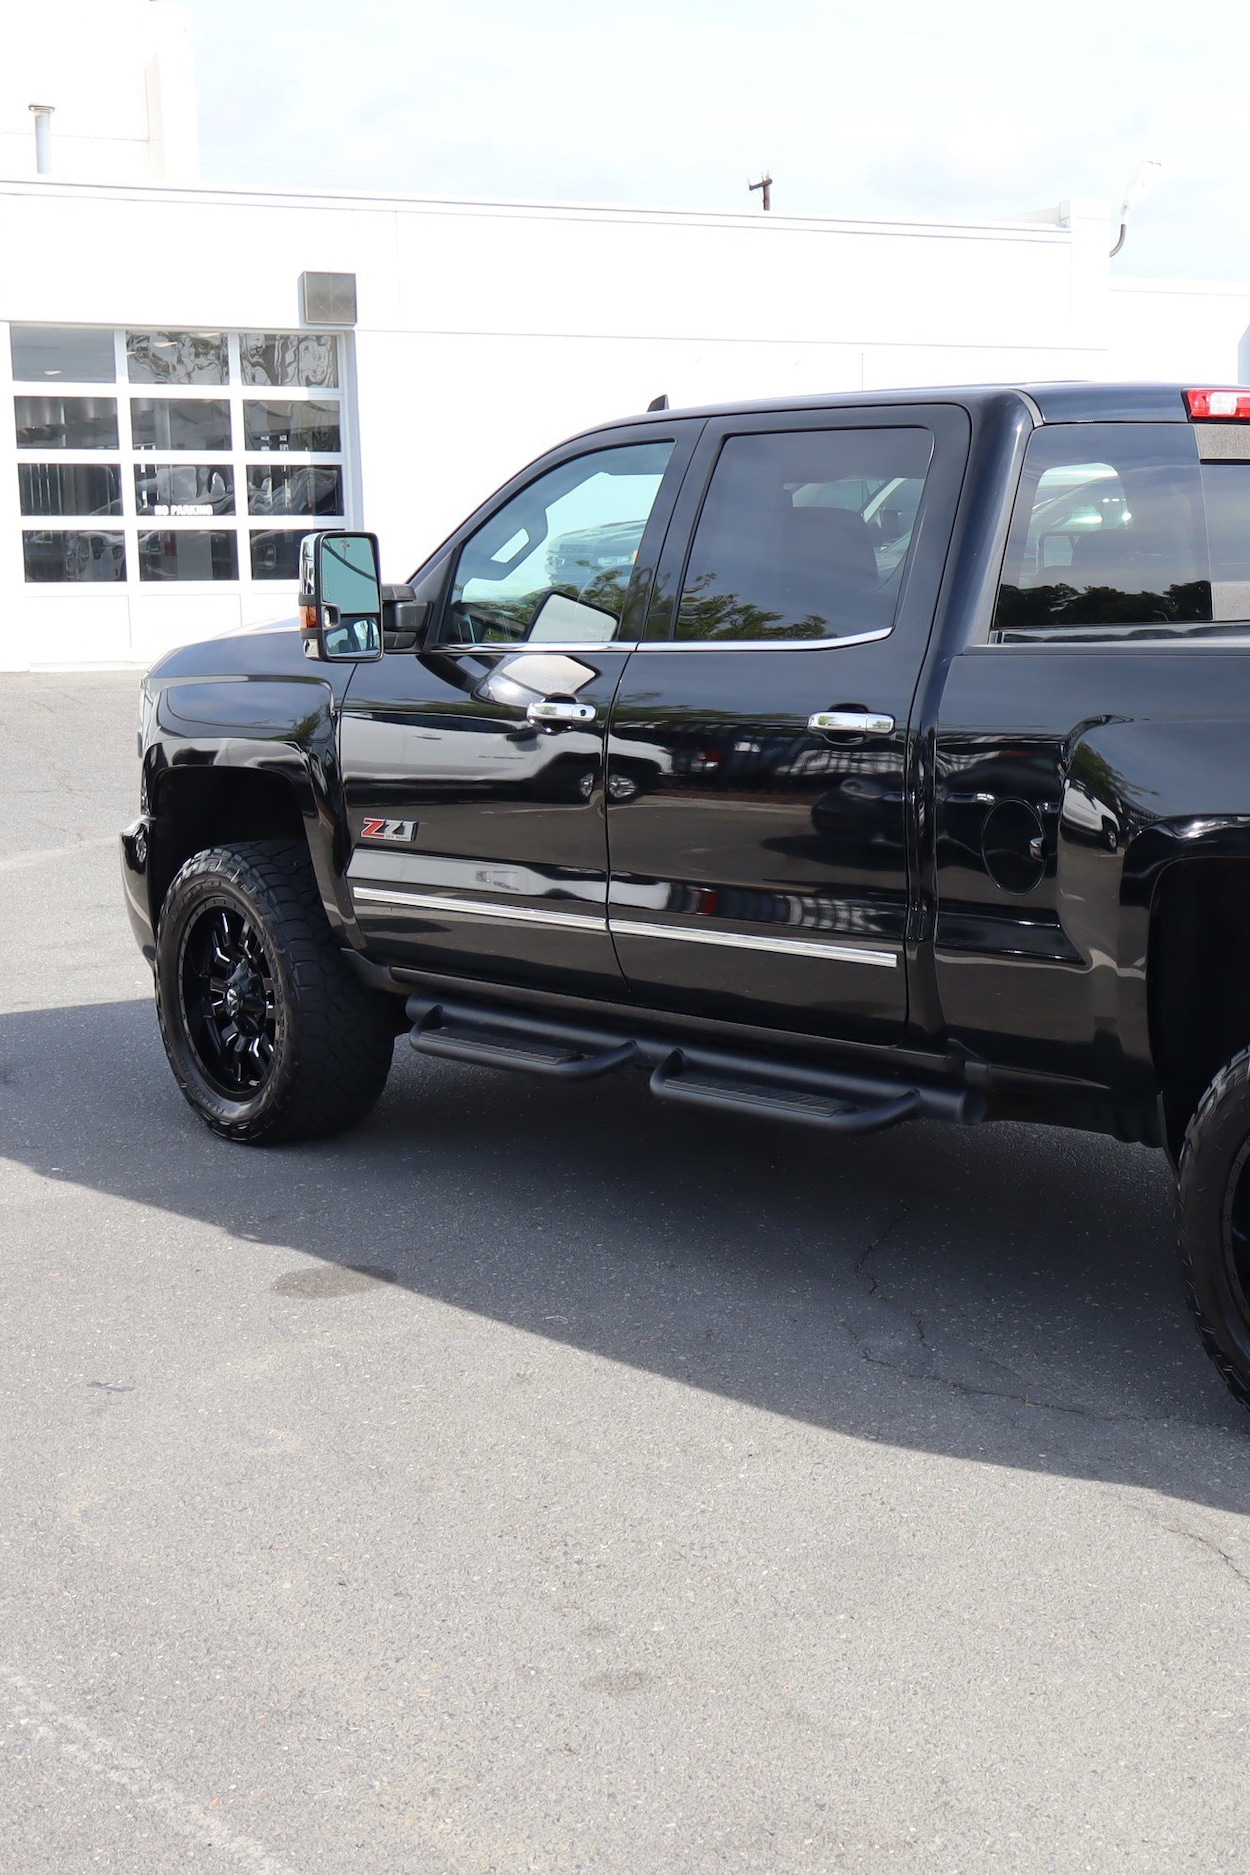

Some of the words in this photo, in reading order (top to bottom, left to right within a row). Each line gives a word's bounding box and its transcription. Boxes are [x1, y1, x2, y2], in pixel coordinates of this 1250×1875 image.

[154, 504, 169, 516] NO
[170, 504, 213, 516] PARKING
[361, 817, 416, 841] Z71
